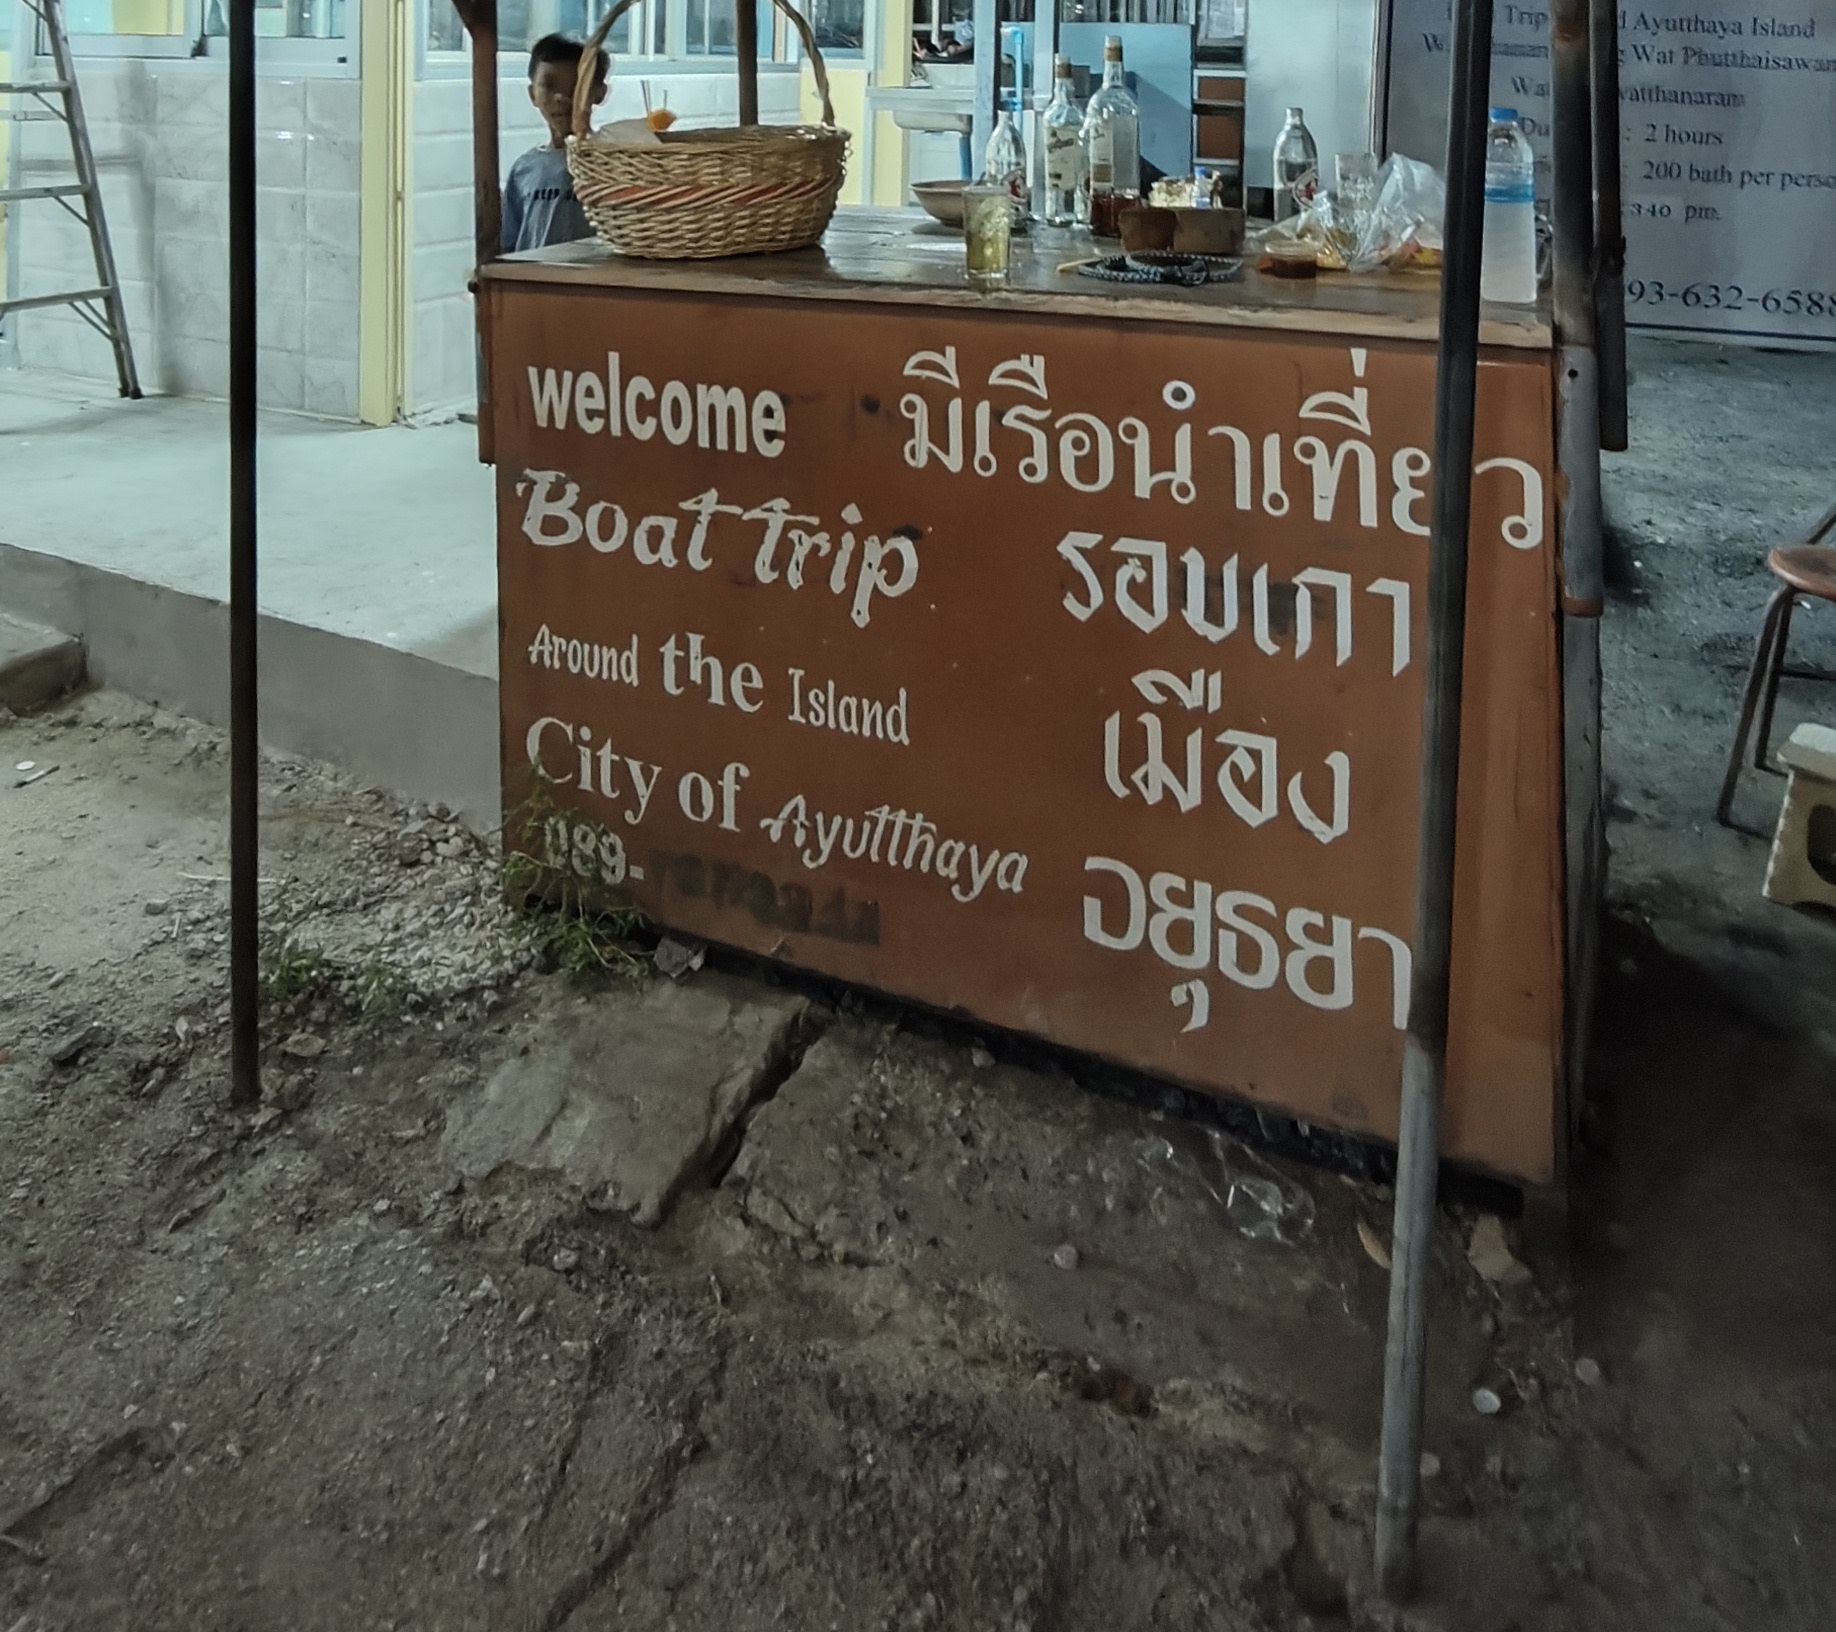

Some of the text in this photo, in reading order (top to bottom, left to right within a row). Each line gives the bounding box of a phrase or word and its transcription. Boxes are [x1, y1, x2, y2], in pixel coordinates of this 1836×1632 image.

[1751, 15, 1816, 40] Island
[1642, 160, 1682, 180] 200
[1739, 169, 1775, 189] per
[1644, 123, 1724, 145] 2 hours
[527, 351, 787, 457] welcome
[516, 468, 744, 571] Boat
[528, 624, 911, 746] Around the Island
[525, 716, 662, 826] City
[678, 762, 750, 832] of
[760, 794, 1029, 903] Ayutthaya
